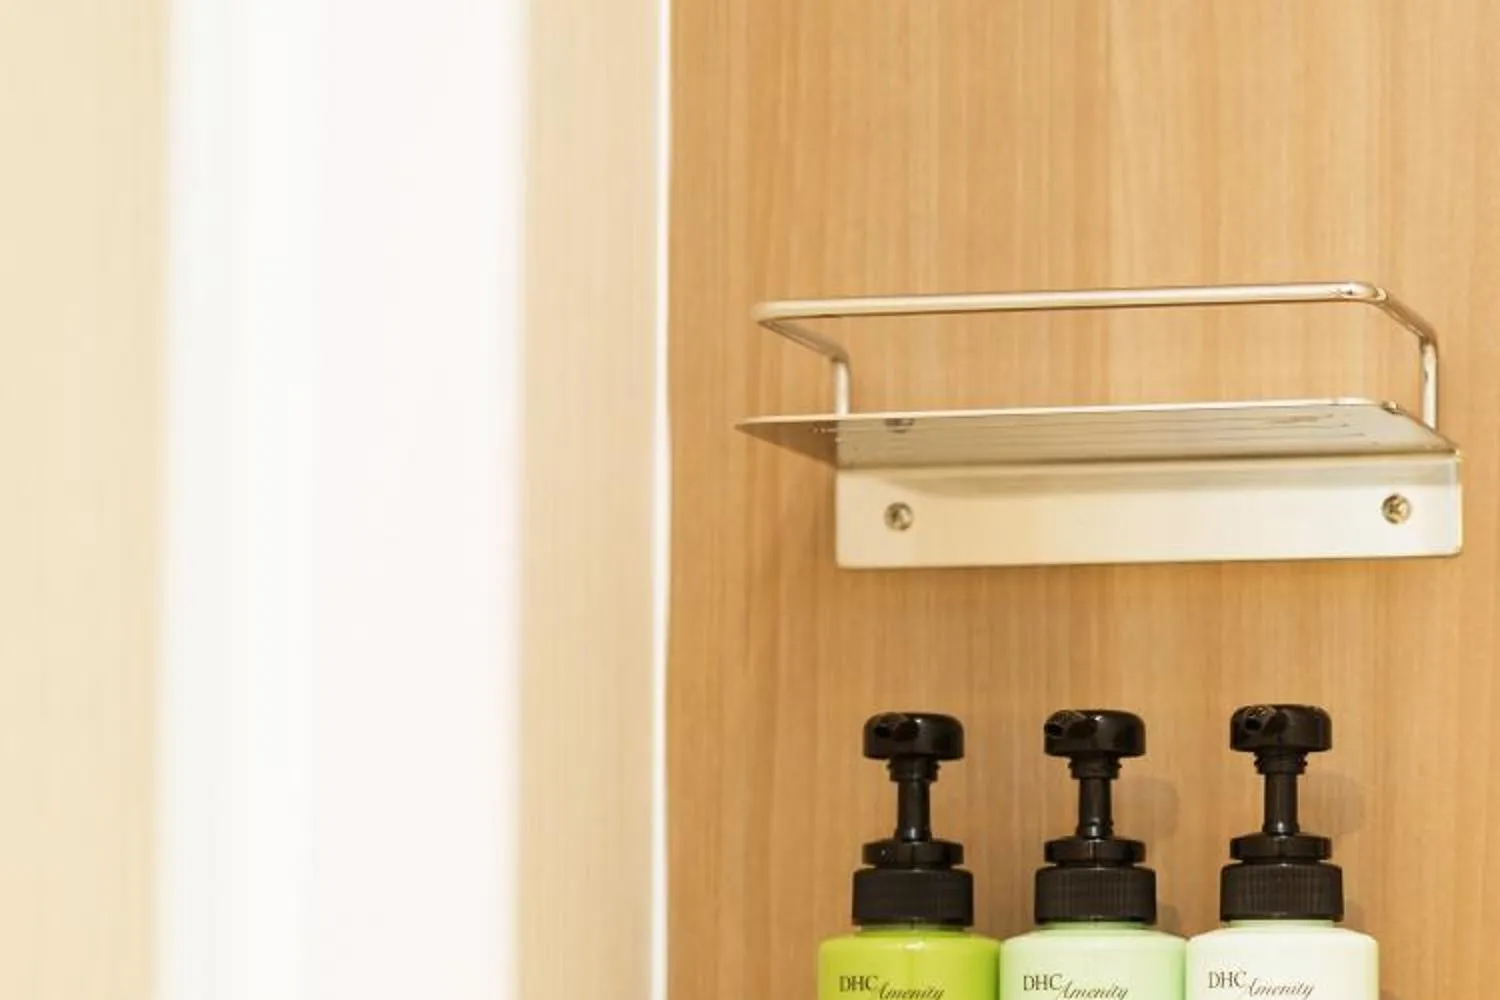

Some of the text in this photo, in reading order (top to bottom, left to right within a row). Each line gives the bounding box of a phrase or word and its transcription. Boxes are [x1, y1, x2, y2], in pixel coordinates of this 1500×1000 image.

[838, 975, 878, 993] DHC
[1022, 973, 1063, 992] DHC
[1207, 970, 1247, 989] DHC
